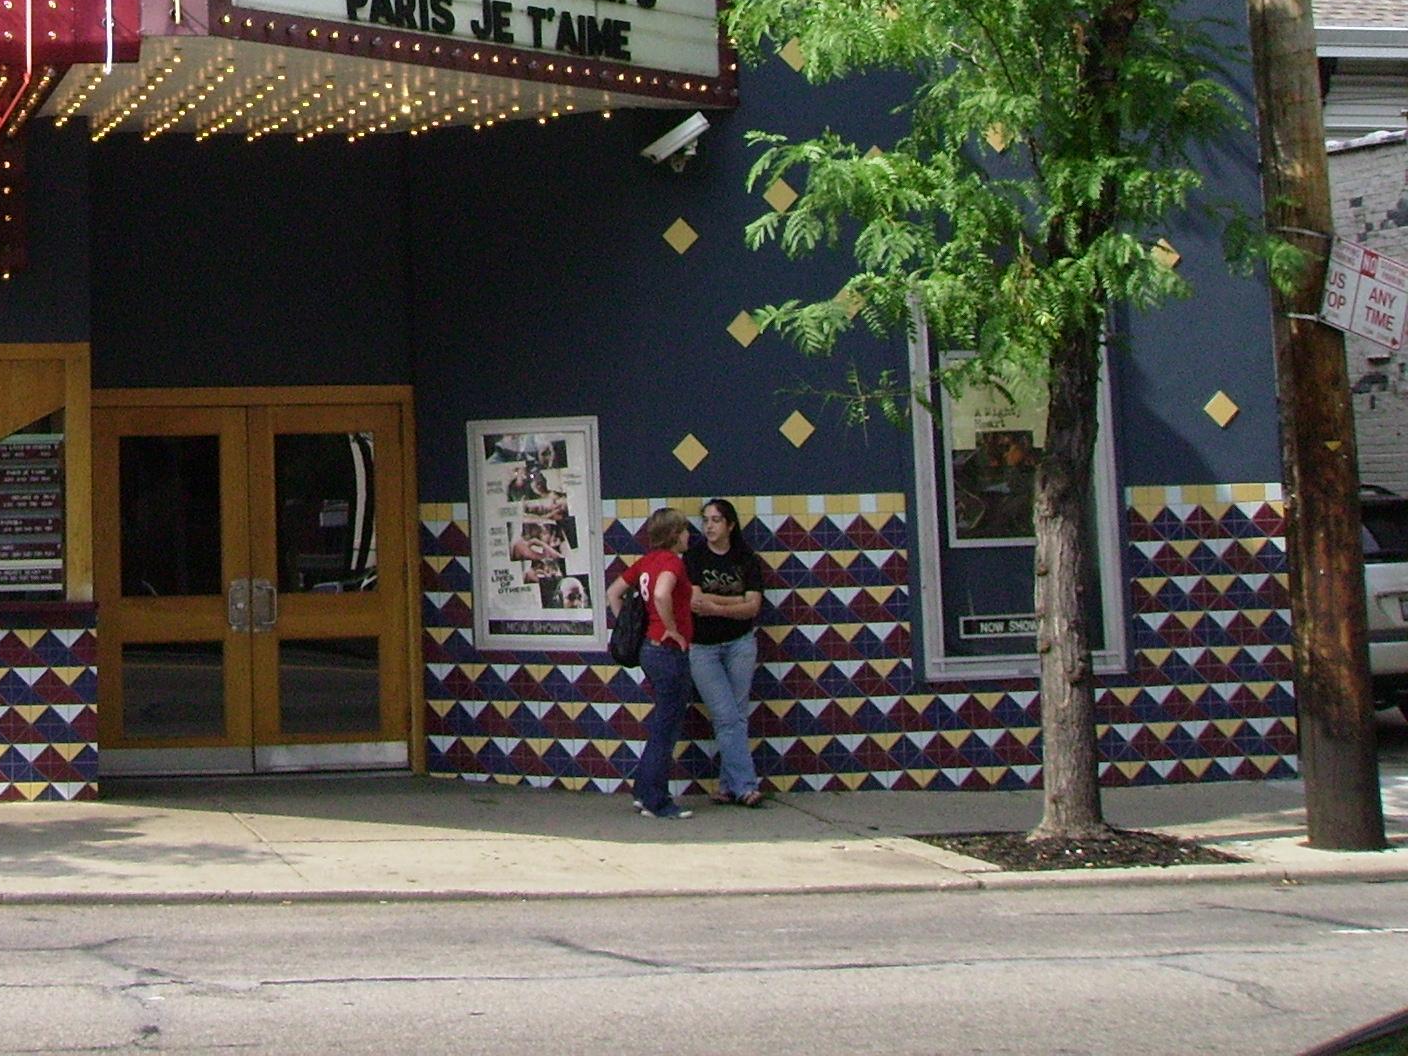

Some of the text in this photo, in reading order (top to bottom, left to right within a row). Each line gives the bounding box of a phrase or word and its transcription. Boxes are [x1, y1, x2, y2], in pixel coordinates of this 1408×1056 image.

[470, 0, 514, 44] JE
[527, 6, 632, 61] T'AIME
[1328, 271, 1347, 290] US
[1368, 287, 1397, 309] ANY
[1365, 305, 1396, 331] TIME
[979, 618, 1037, 634] NOW SHOW
